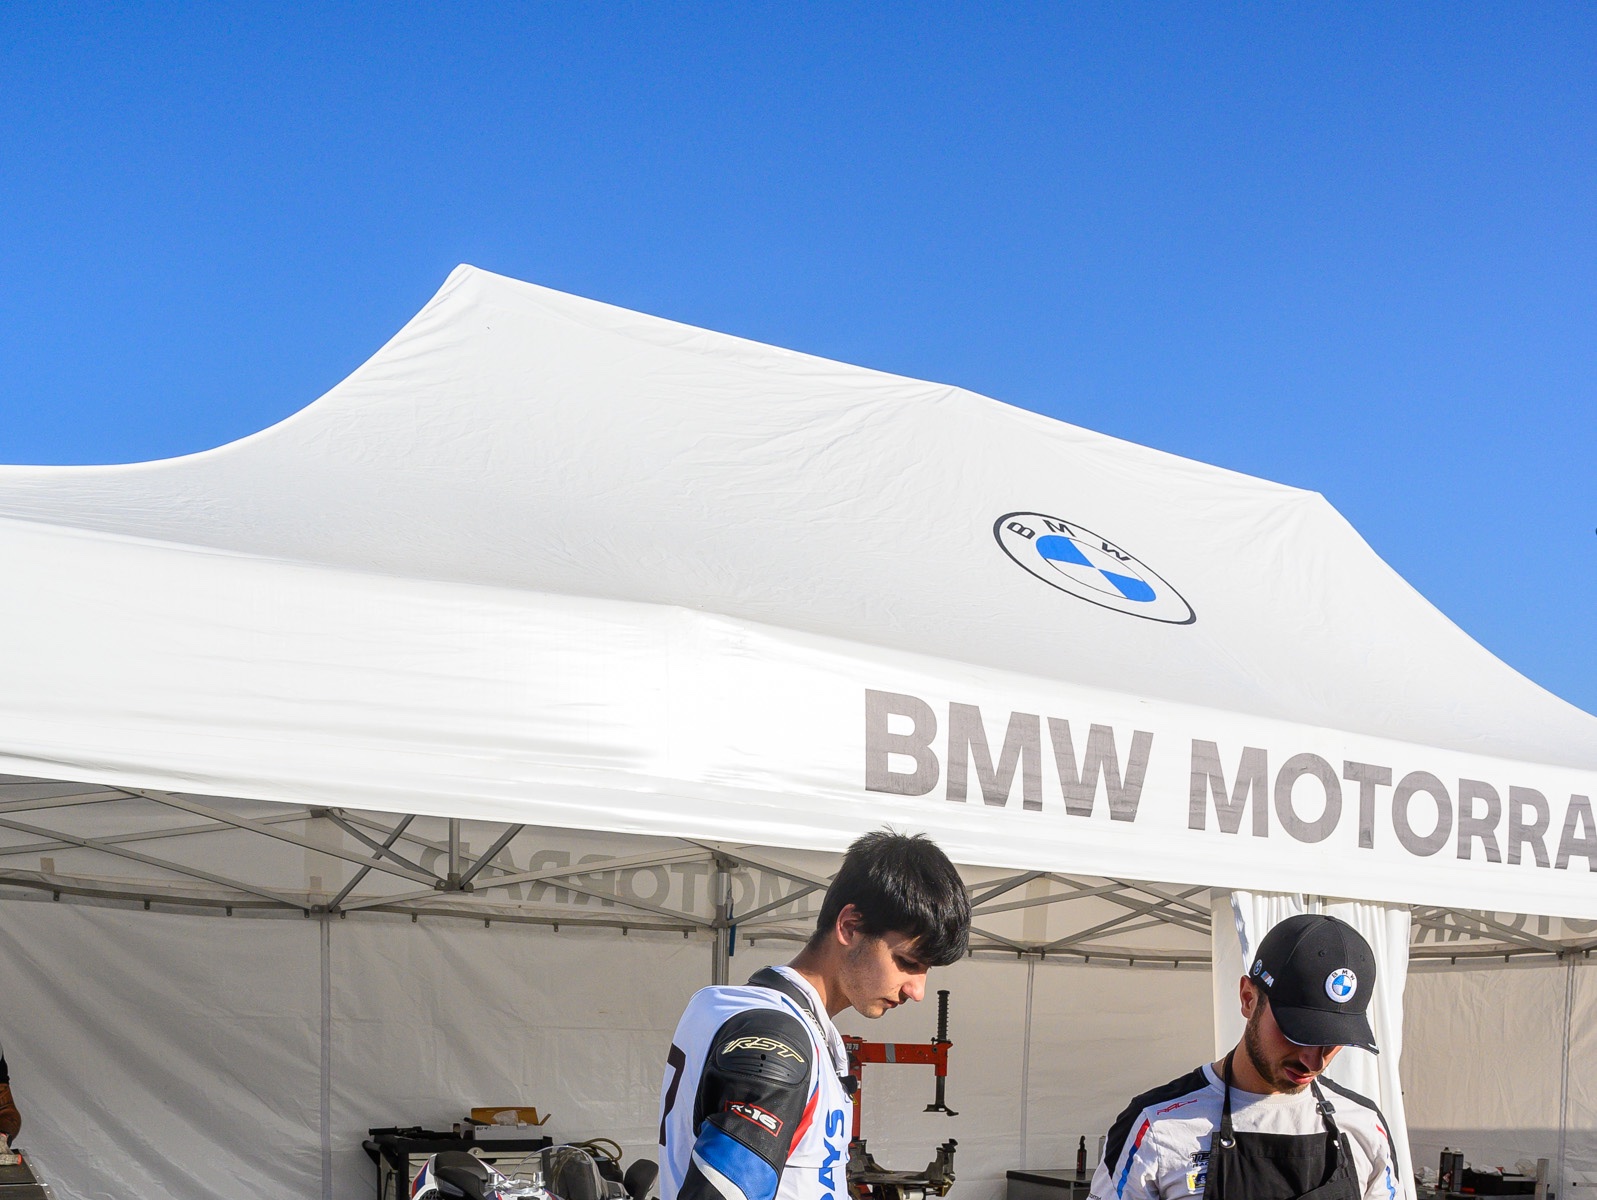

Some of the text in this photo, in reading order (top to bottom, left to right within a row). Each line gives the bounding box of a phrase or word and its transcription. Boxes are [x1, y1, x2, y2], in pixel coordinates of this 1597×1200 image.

[1007, 518, 1133, 562] BMW
[865, 688, 1597, 872] BMW MOTORRA
[722, 1036, 805, 1063] RST
